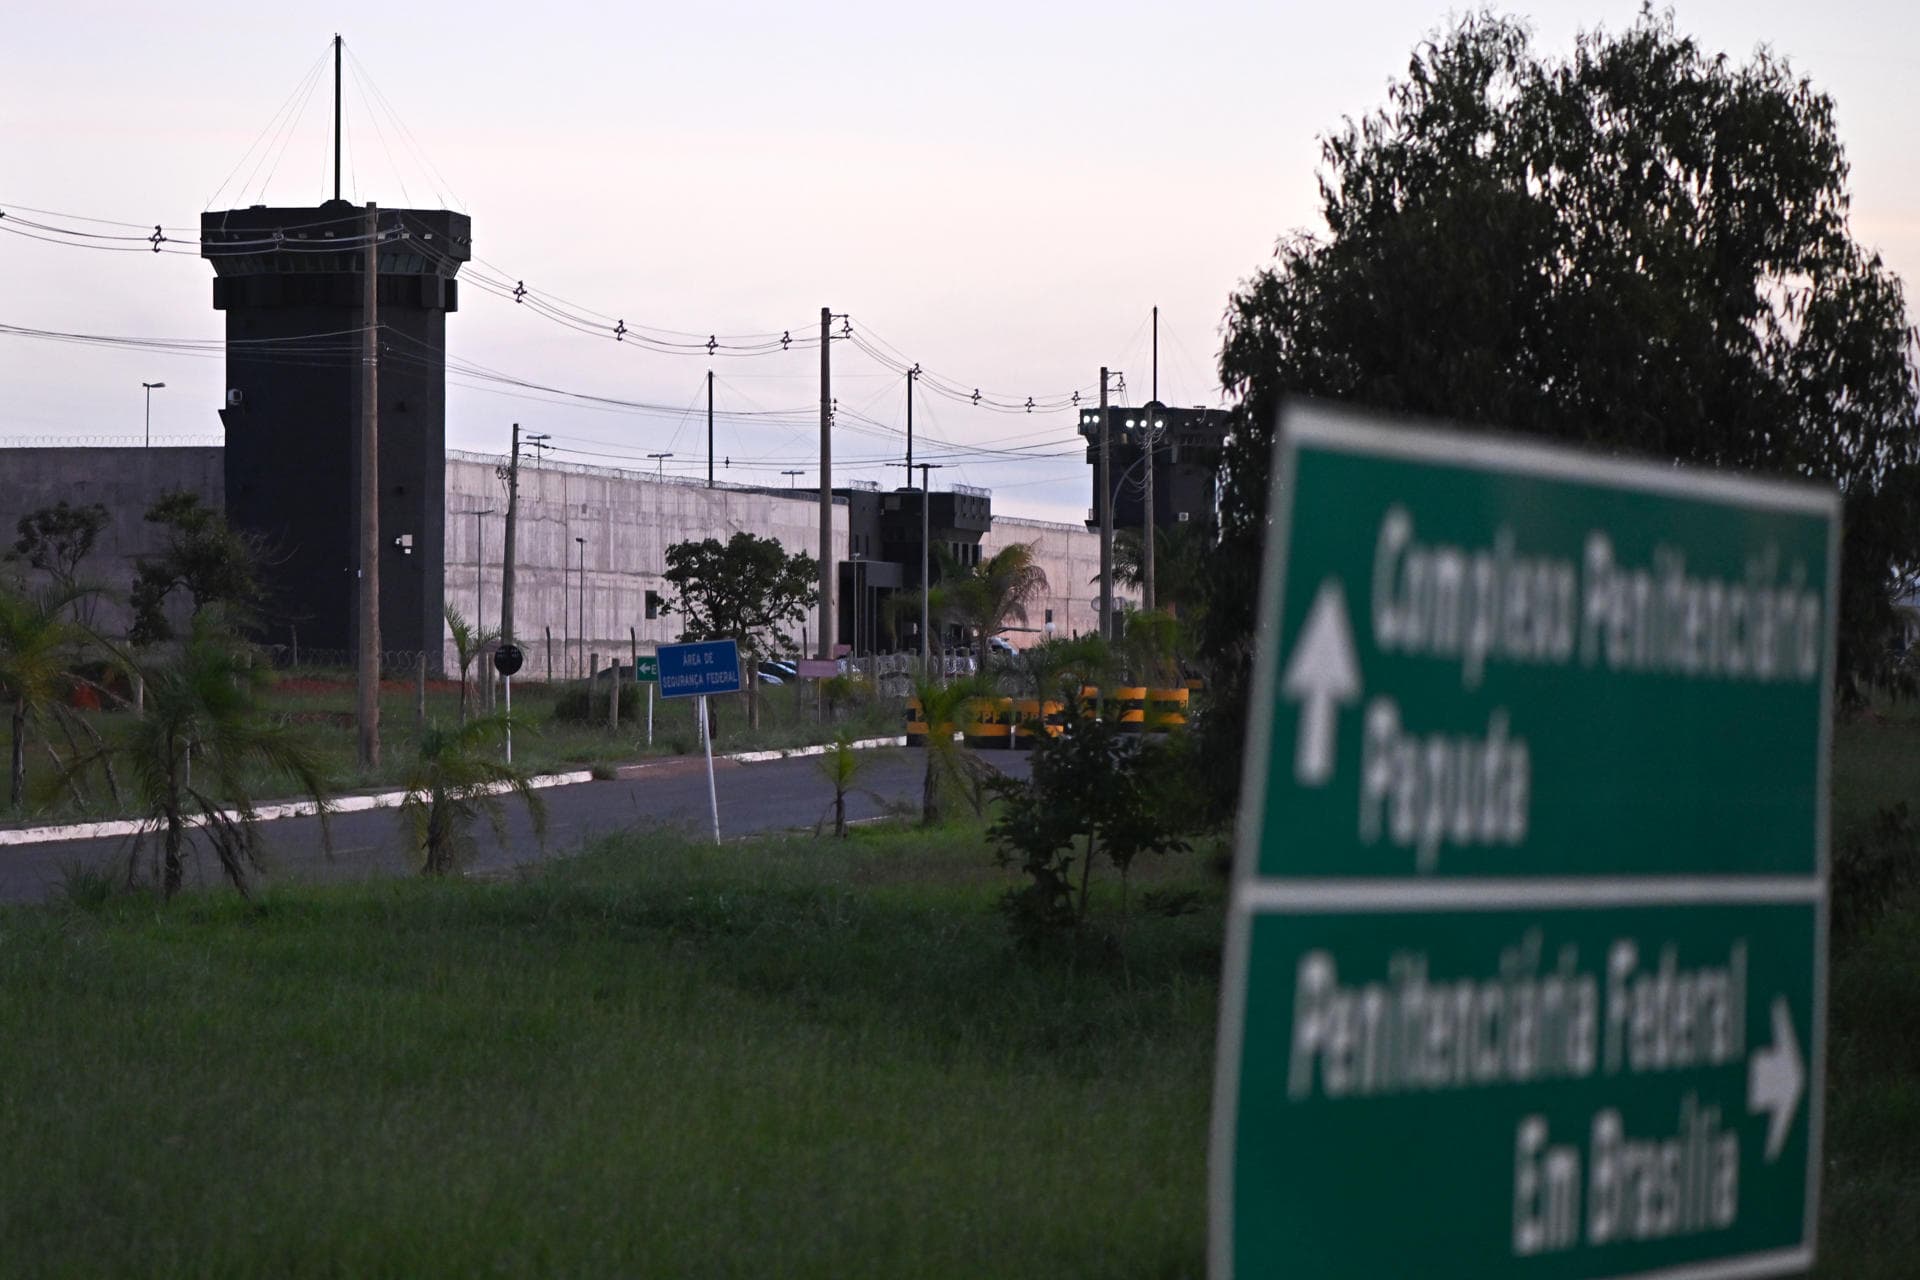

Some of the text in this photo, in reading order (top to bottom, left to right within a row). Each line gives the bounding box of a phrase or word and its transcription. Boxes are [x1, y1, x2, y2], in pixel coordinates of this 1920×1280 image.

[683, 650, 714, 667] ÁREA DE
[662, 671, 737, 688] SEGURANÇA FEDERAL
